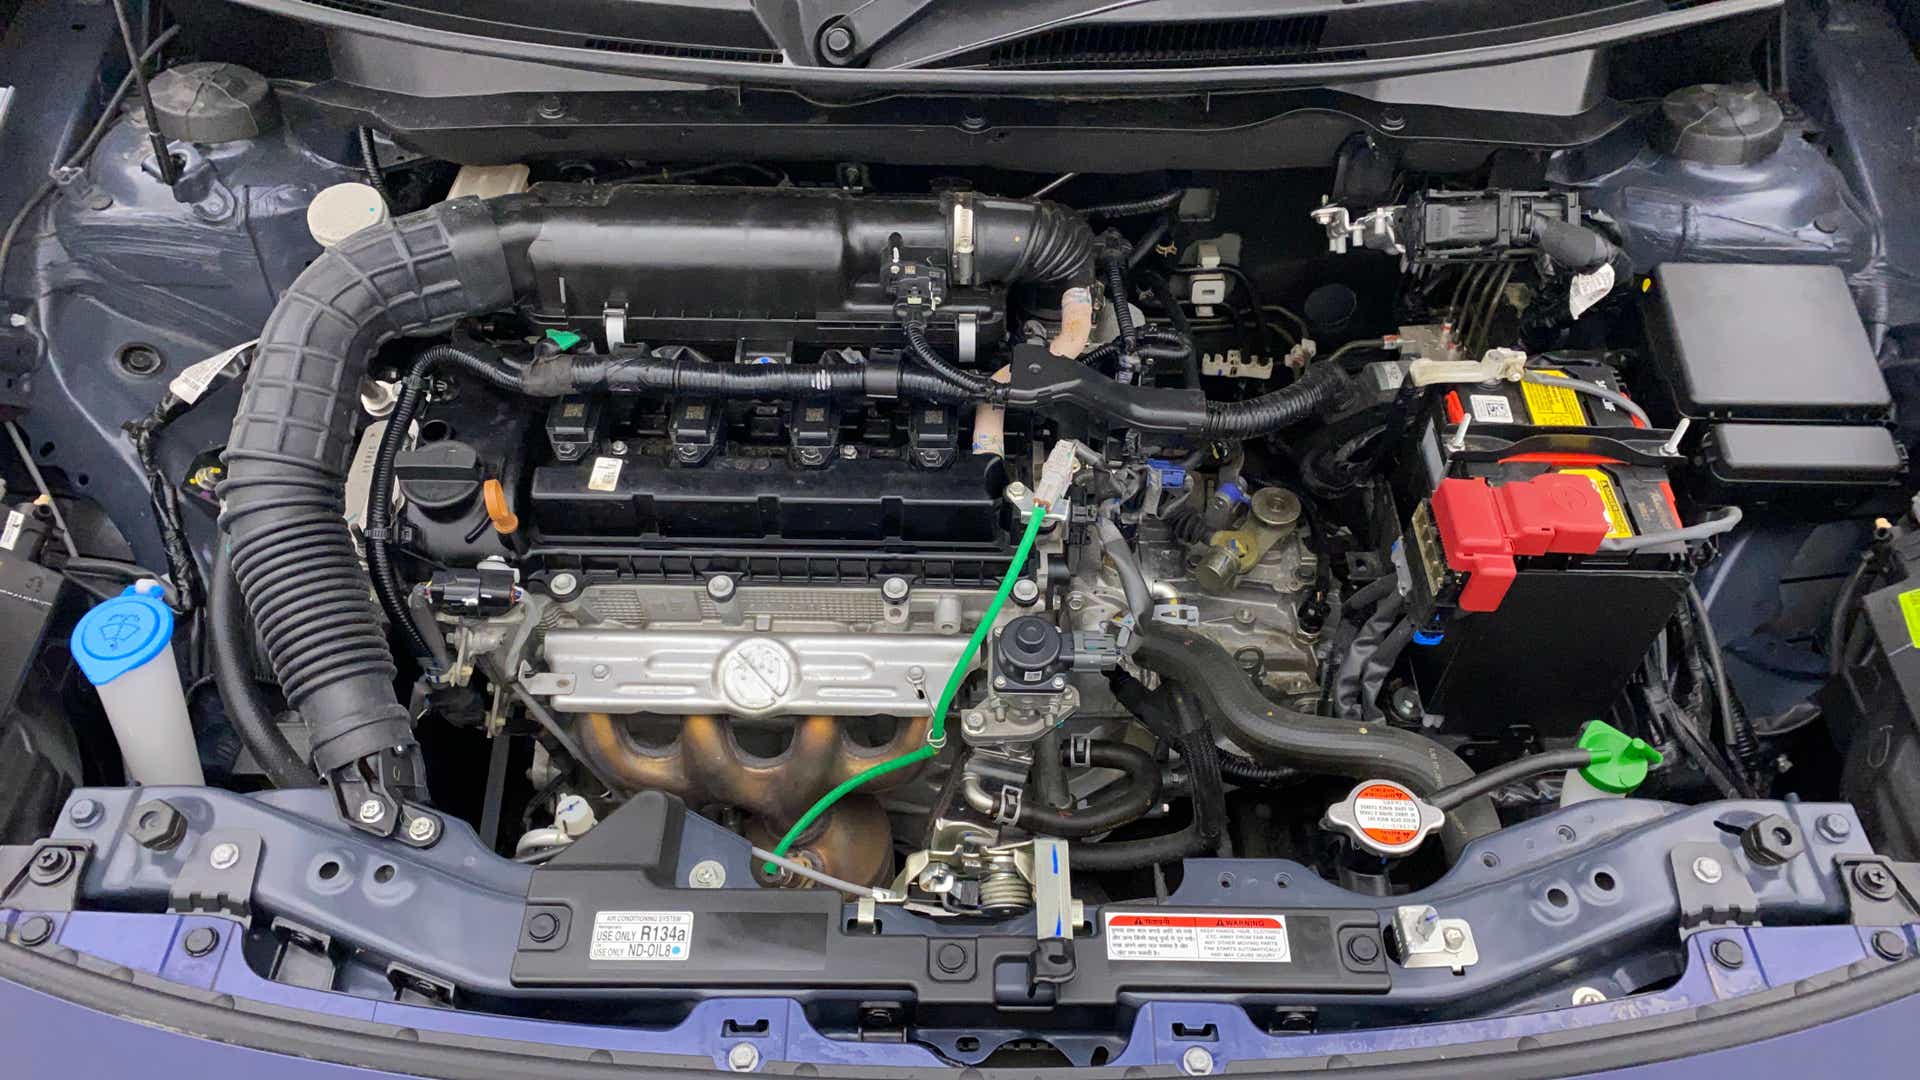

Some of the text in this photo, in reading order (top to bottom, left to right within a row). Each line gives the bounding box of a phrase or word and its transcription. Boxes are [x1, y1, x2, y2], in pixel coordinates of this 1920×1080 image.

[596, 926, 685, 941] USE ONLY R134a
[594, 948, 607, 956] USE
[628, 944, 671, 957] ND-OIL8
